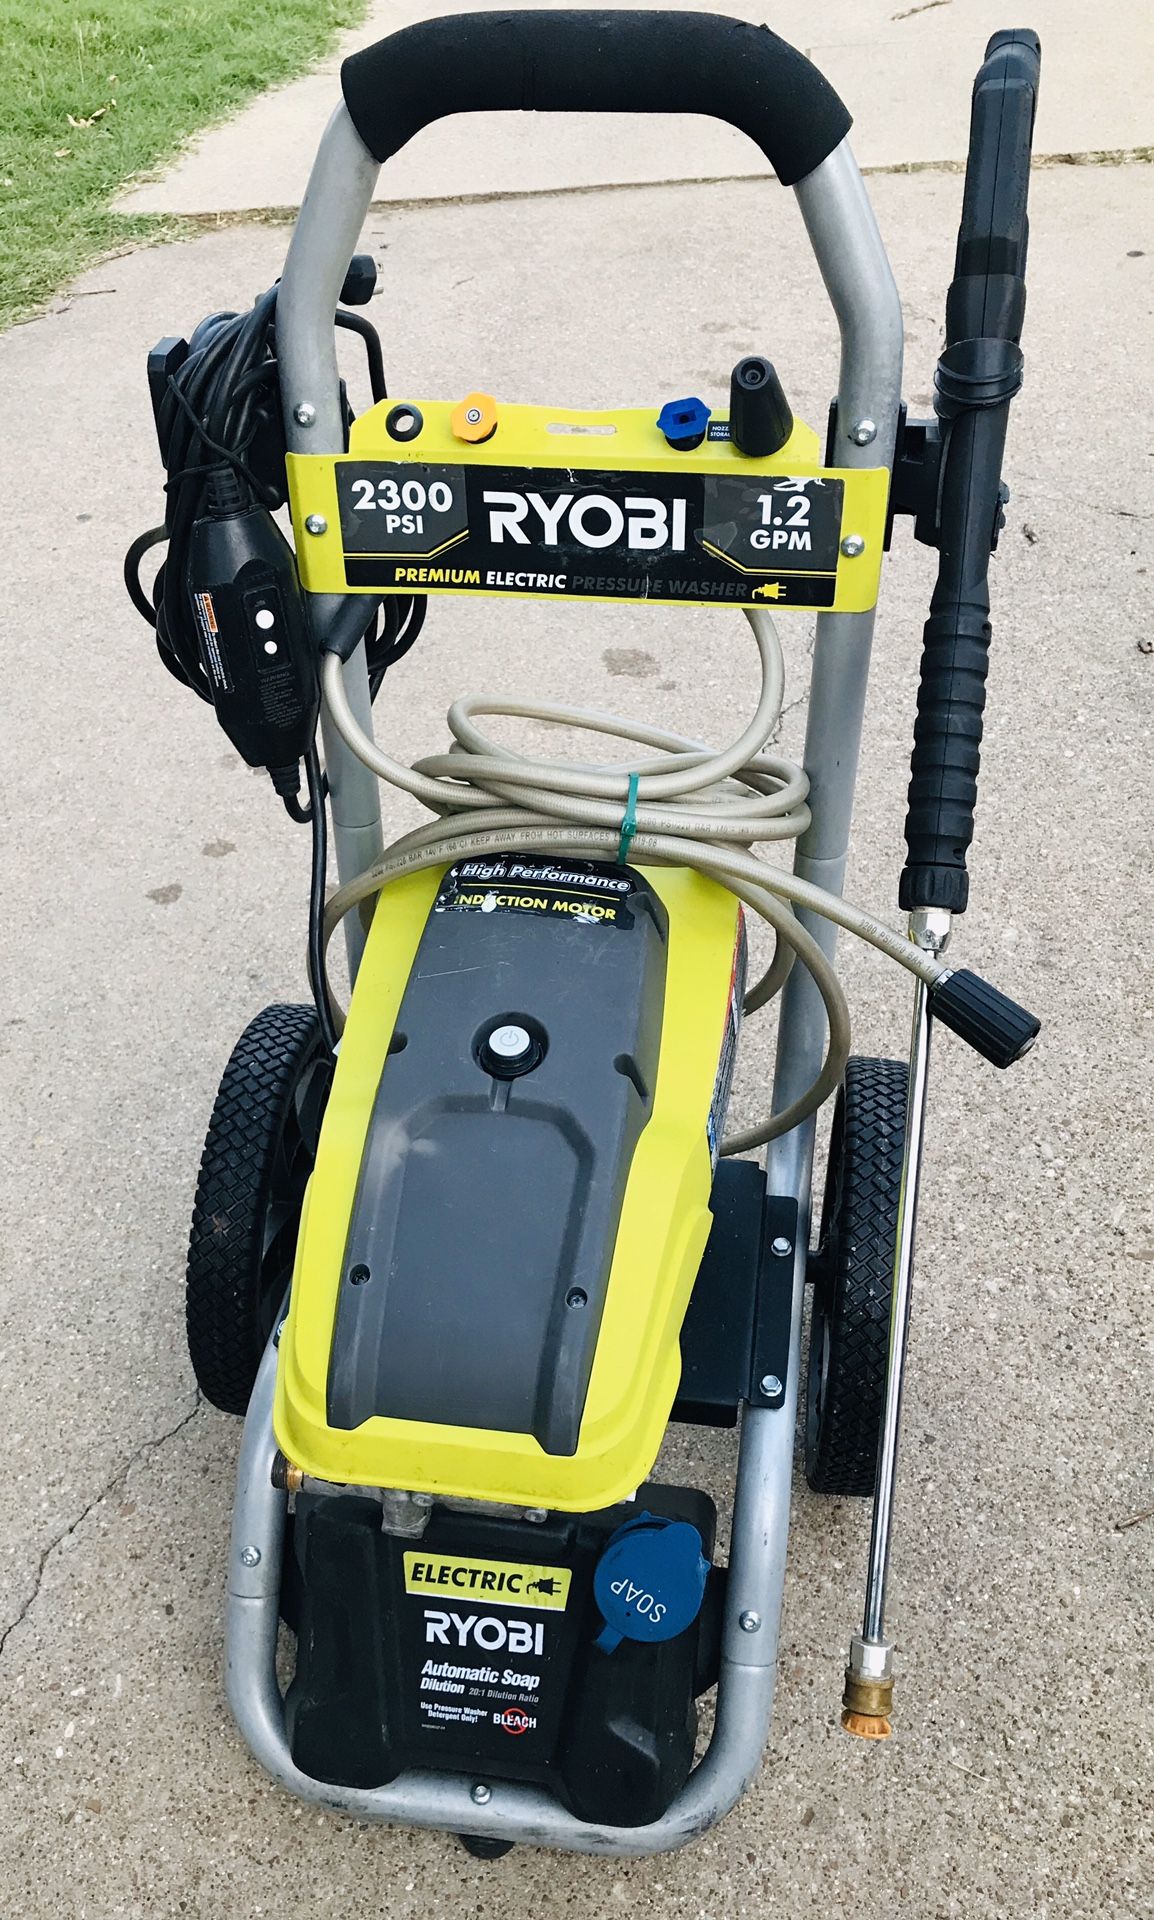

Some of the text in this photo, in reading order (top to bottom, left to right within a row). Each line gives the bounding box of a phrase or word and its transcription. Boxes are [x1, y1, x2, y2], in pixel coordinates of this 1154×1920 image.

[351, 479, 453, 513] 2300
[756, 494, 811, 527] 1.2
[385, 514, 424, 534] PSI
[483, 490, 687, 551] RYOBI
[750, 529, 812, 551] GPM
[394, 567, 748, 597] PREMIUM ELECTRIC PRESSURE WASHER
[204, 601, 217, 630] WARNING
[470, 836, 490, 846] KEEP
[495, 833, 516, 843] AWAY
[520, 831, 543, 841] FROM
[547, 830, 562, 840] HOT
[567, 831, 610, 841] SURFACES
[459, 862, 631, 892] High Performance
[453, 894, 617, 920] INDCTION MOTOR
[411, 1562, 523, 1594] ELECTRIC
[610, 1578, 667, 1623] SOAP
[423, 1609, 545, 1656] RYOBI
[421, 1659, 541, 1691] Automatic Soap
[420, 1677, 539, 1703] Dilution 20:1 Dilution Ratio
[420, 1701, 488, 1717] Use Pressure Washer
[427, 1709, 479, 1724] Detergent Only!
[492, 1712, 537, 1729] BLEACH
